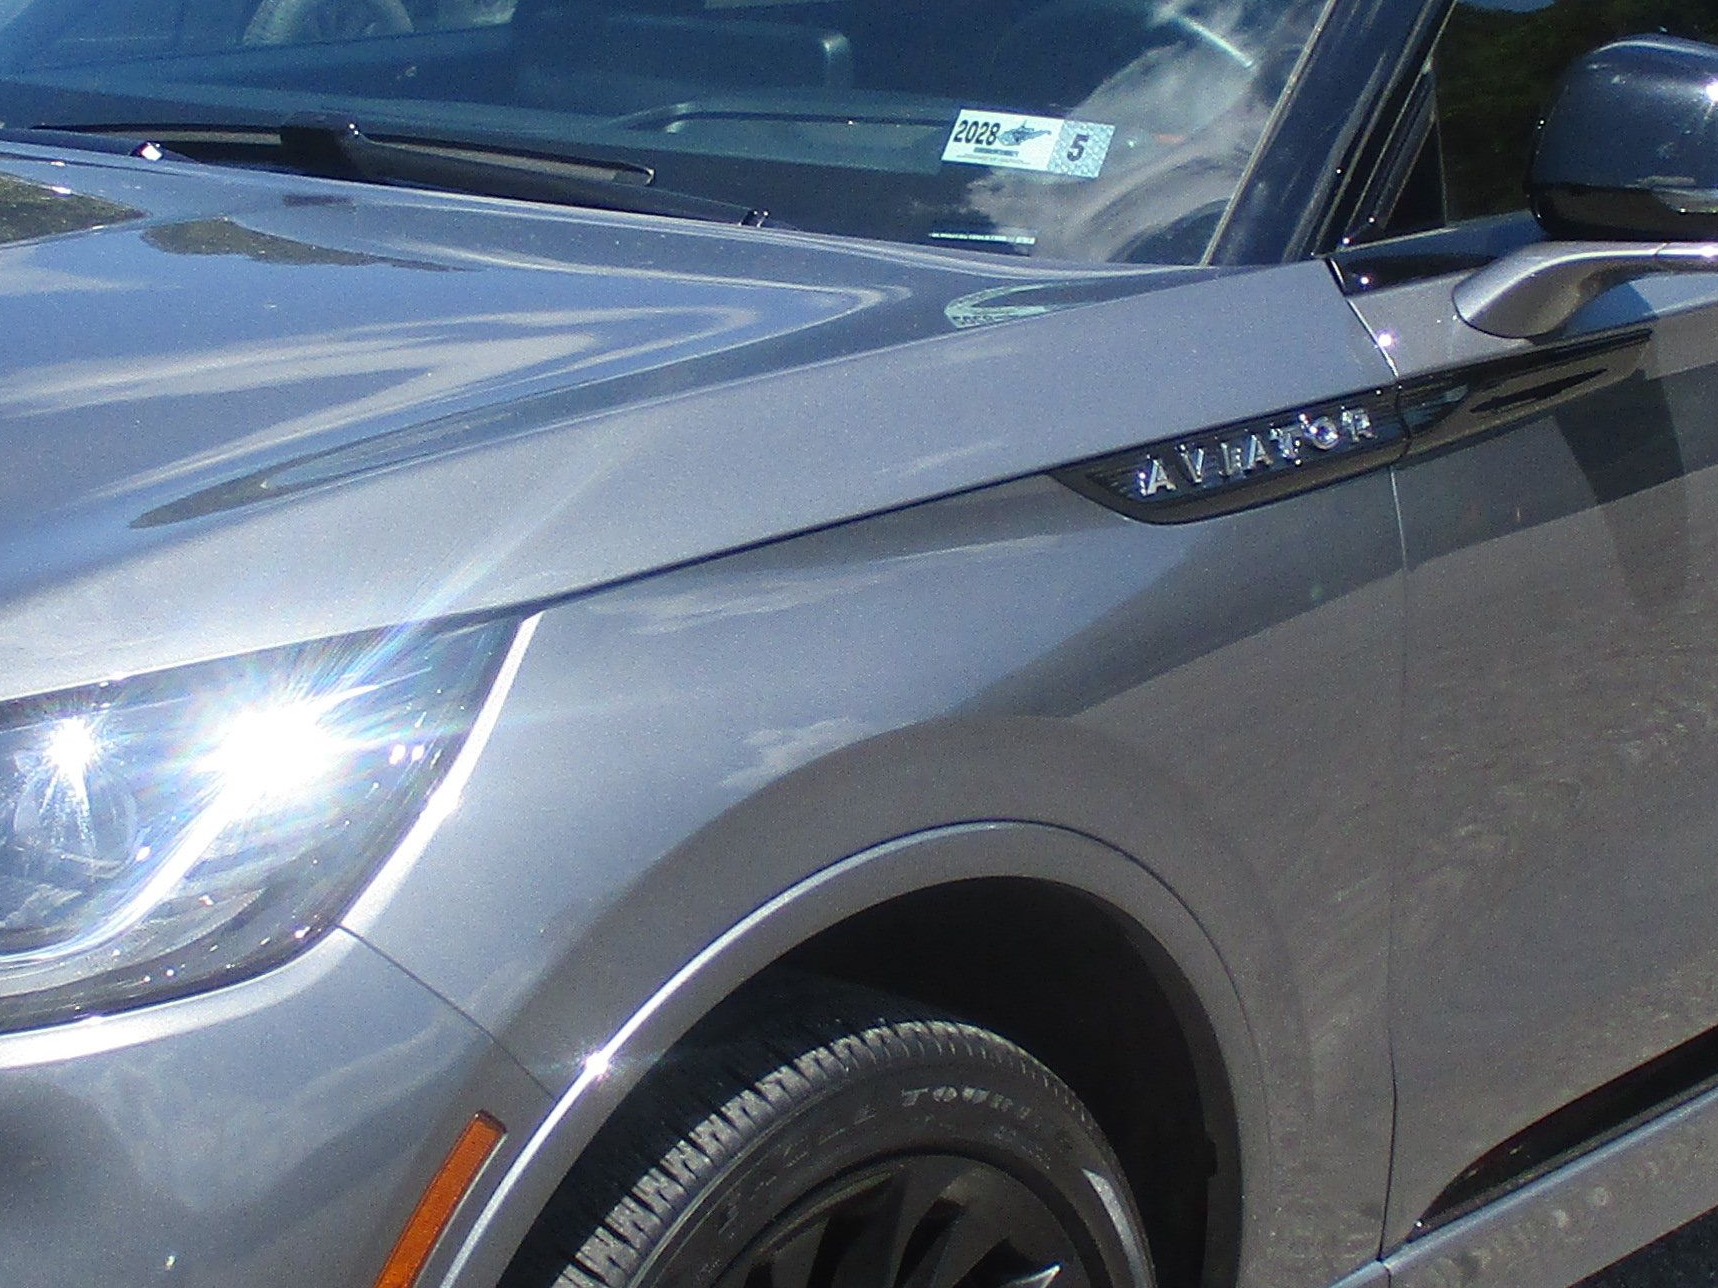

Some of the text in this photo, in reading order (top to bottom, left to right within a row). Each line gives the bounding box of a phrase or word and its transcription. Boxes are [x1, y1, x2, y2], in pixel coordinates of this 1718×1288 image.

[953, 119, 1090, 162] 2028 5
[1137, 405, 1377, 497] AVIATOR
